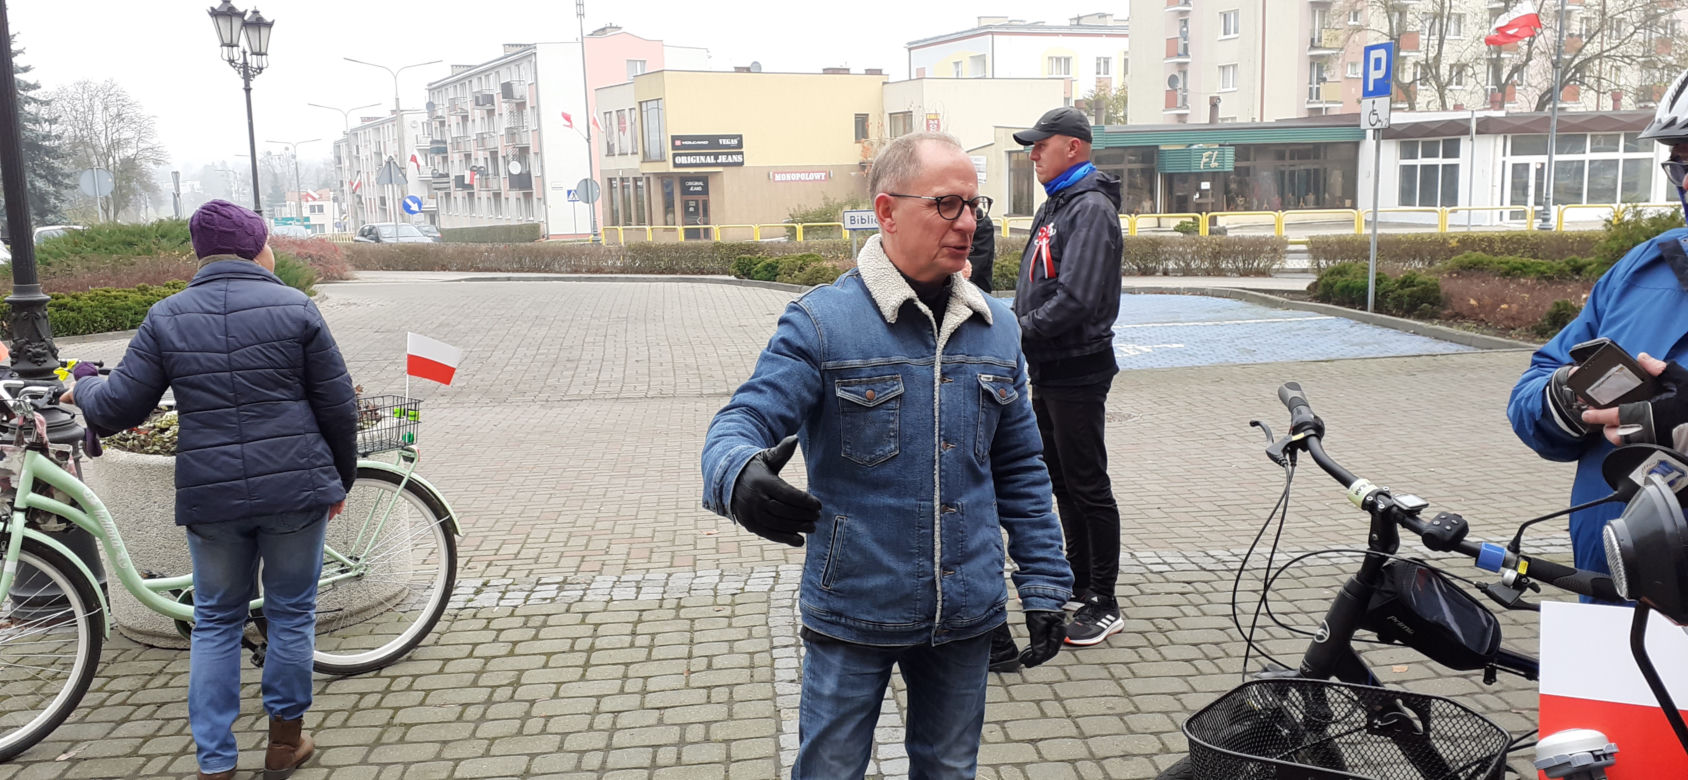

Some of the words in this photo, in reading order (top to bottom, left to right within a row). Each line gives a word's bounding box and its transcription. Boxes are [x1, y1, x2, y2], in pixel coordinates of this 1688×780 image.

[1368, 48, 1387, 92] P
[675, 155, 716, 164] ORIGINAL
[717, 154, 743, 163] JEANS
[774, 172, 826, 181] MONOPOLOWY
[850, 215, 878, 225] Biblio
